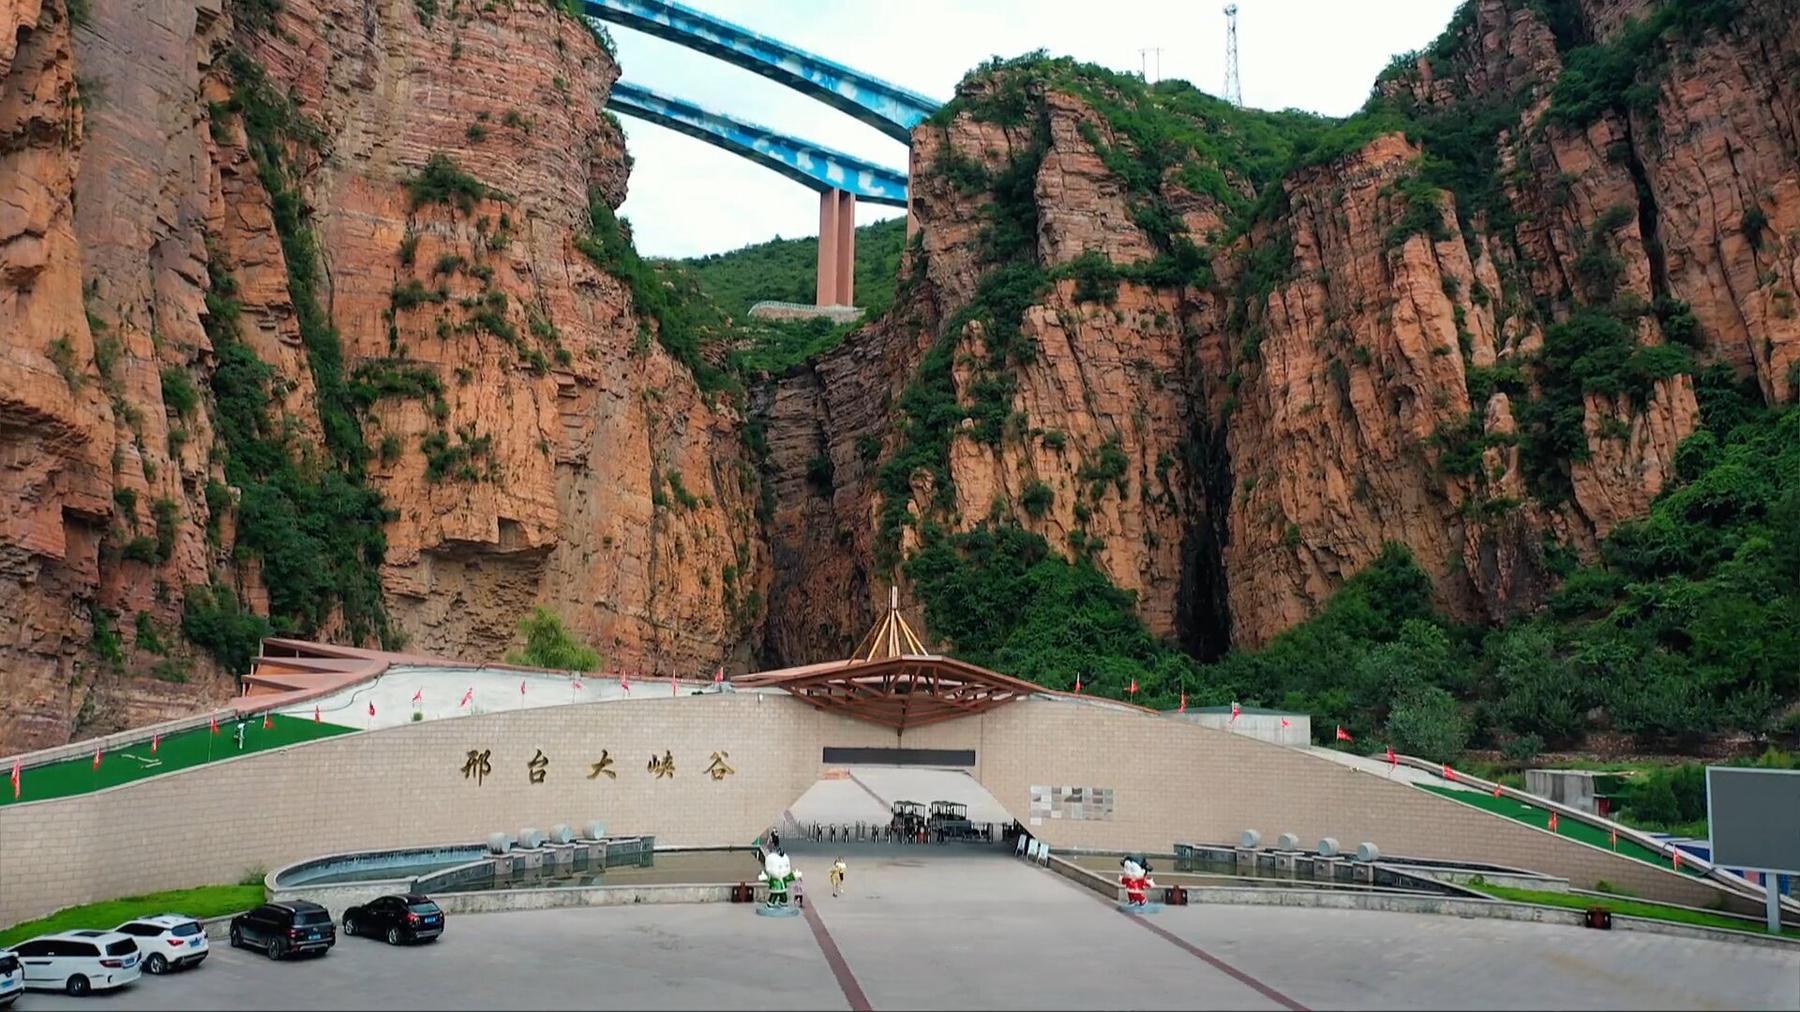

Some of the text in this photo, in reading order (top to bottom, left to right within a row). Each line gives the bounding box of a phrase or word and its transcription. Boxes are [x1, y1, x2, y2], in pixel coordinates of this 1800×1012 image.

[460, 749, 735, 787] 邢台大峡谷
